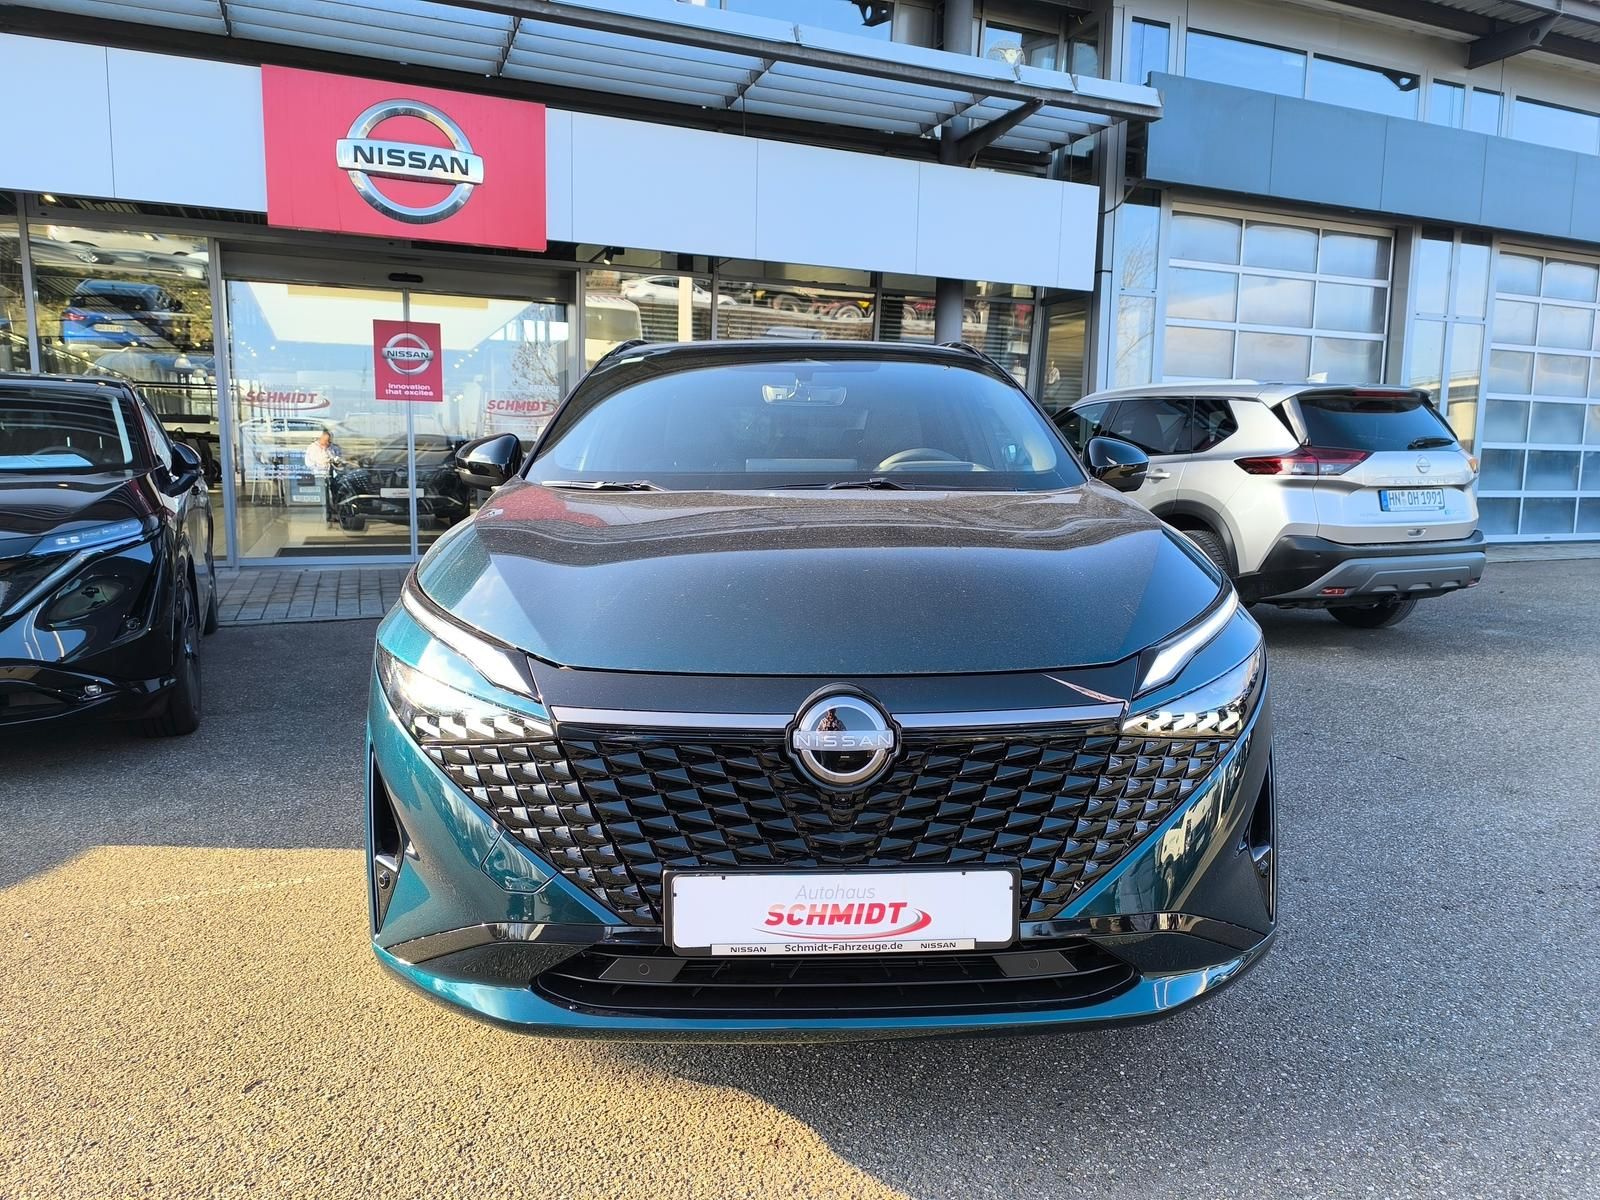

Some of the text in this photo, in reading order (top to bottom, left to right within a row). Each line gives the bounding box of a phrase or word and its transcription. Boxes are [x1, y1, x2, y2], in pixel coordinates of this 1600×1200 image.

[353, 145, 469, 176] NISSAN
[386, 350, 429, 359] NISSAN
[245, 391, 318, 403] SCHMIDT
[487, 400, 549, 411] SCHMIDT
[1389, 492, 1401, 505] HN
[1421, 492, 1443, 505] 1991
[796, 734, 891, 747] NISSAN
[795, 884, 876, 900] Autohaus
[765, 902, 907, 926] SCHMIDT
[784, 942, 904, 953] Schmidt-Fahrzeuge.de
[920, 941, 957, 949] NISSAN
